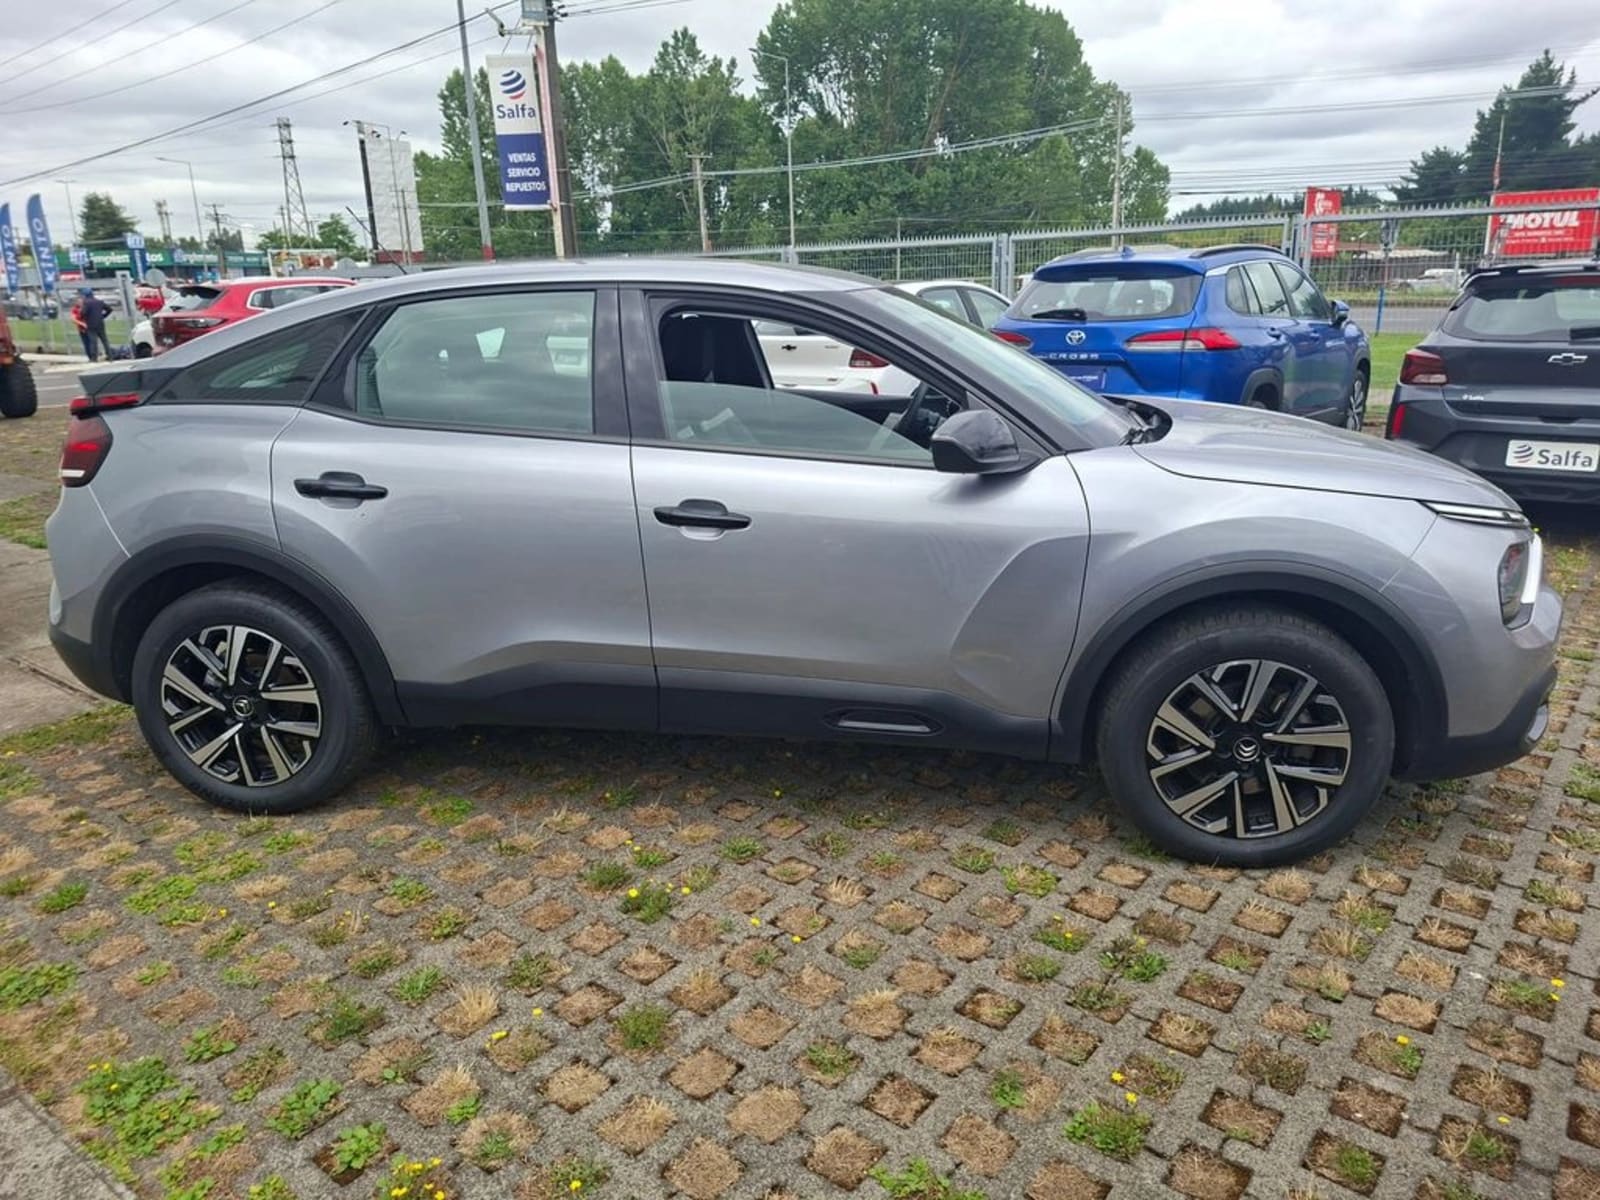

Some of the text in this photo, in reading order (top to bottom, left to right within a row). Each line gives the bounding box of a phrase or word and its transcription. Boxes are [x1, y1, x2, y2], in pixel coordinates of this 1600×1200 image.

[496, 104, 537, 119] Salfa
[507, 152, 537, 163] VENTAS
[506, 167, 541, 177] SERVICIO
[505, 181, 547, 192] REPUESTOS
[1509, 211, 1580, 229] MOTUL
[32, 217, 55, 281] KINTO
[89, 252, 164, 266] implemtos
[1537, 448, 1593, 467] Salfa
